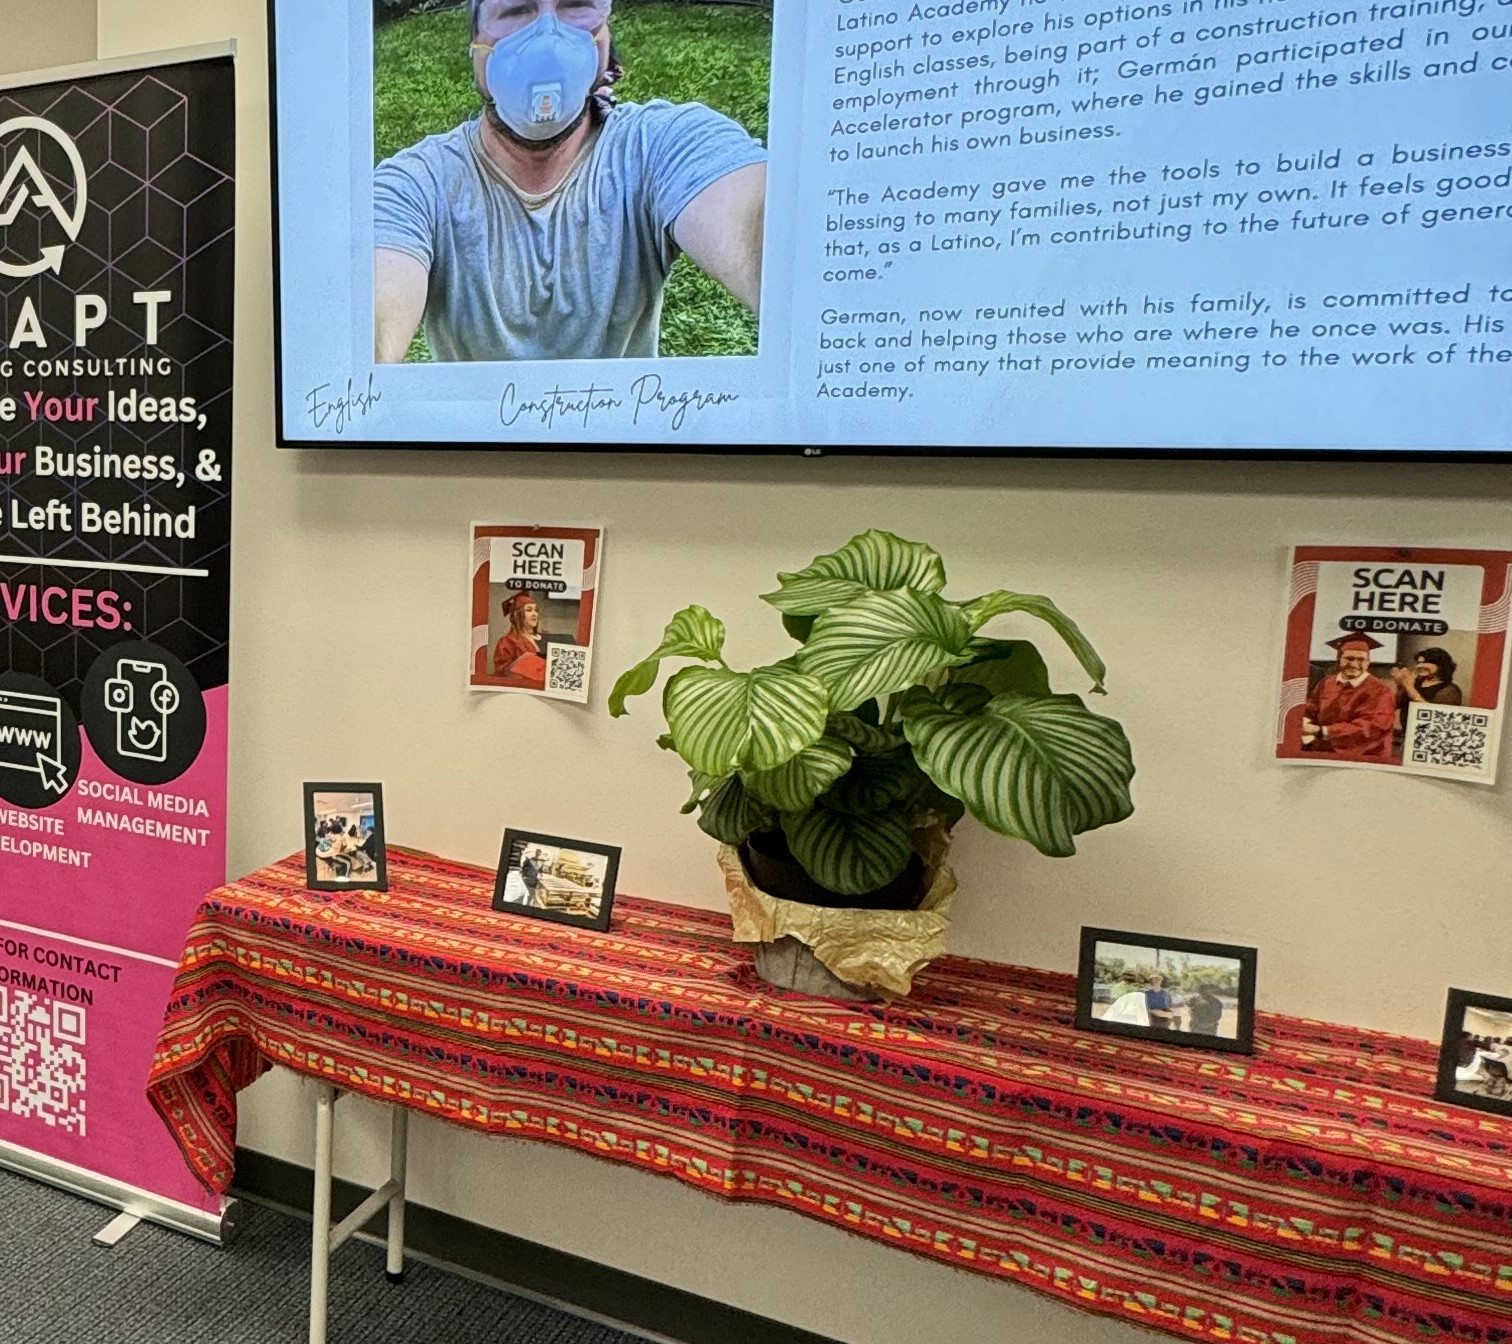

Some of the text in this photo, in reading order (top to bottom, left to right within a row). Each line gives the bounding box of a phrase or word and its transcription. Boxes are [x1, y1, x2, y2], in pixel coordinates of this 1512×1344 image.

[834, 33, 914, 62] support
[951, 18, 1035, 47] explore
[1043, 11, 1075, 33] his
[1083, 3, 1173, 31] options
[837, 11, 899, 32] Latino
[834, 58, 905, 87] English
[912, 54, 996, 75] classes,
[1004, 44, 1068, 65] being
[1076, 33, 1128, 63] part
[1195, 9, 1358, 42] construction
[832, 27, 1406, 113] employment through Germán participated
[829, 50, 1480, 137] Accelerator program, where gained the skills and
[856, 124, 1122, 160] launch his own business.
[880, 180, 981, 203] Academy
[991, 178, 1047, 200] gave
[1107, 164, 1148, 186] the
[1160, 157, 1221, 182] tools
[1276, 147, 1342, 173] build
[1391, 142, 1511, 165] business
[825, 165, 1512, 233] blessing many families, not just own. feels good
[823, 238, 870, 259] that,
[931, 233, 1002, 252] Latino,
[1049, 220, 1192, 245] contributing
[1238, 212, 1280, 234] the
[1290, 209, 1370, 231] future
[820, 282, 1472, 326] German, now reunited with his family, committed
[819, 313, 1505, 353] back and helping those who are where once was. His
[23, 357, 172, 378] CONSULTING
[815, 342, 1512, 380] just one many that provide meaning the work the
[24, 390, 99, 423] Your
[108, 389, 207, 431] Ideas,
[305, 372, 382, 434] English
[499, 373, 740, 430] Construction Program
[815, 380, 914, 404] Academy.
[35, 446, 185, 489] Business,
[195, 449, 223, 482] &
[11, 499, 72, 533] Left
[81, 502, 196, 539] Behind
[512, 541, 564, 560] SCAN
[512, 559, 563, 577] HERE
[508, 580, 564, 591] TO DONATE
[1352, 568, 1445, 591] SCAN
[1352, 591, 1442, 614] HERE
[1344, 618, 1443, 633] TO DONATE
[77, 778, 209, 818] SOCIAL MEDIA
[76, 807, 210, 848] MANAGEMENT
[33, 948, 122, 984] CONTACT
